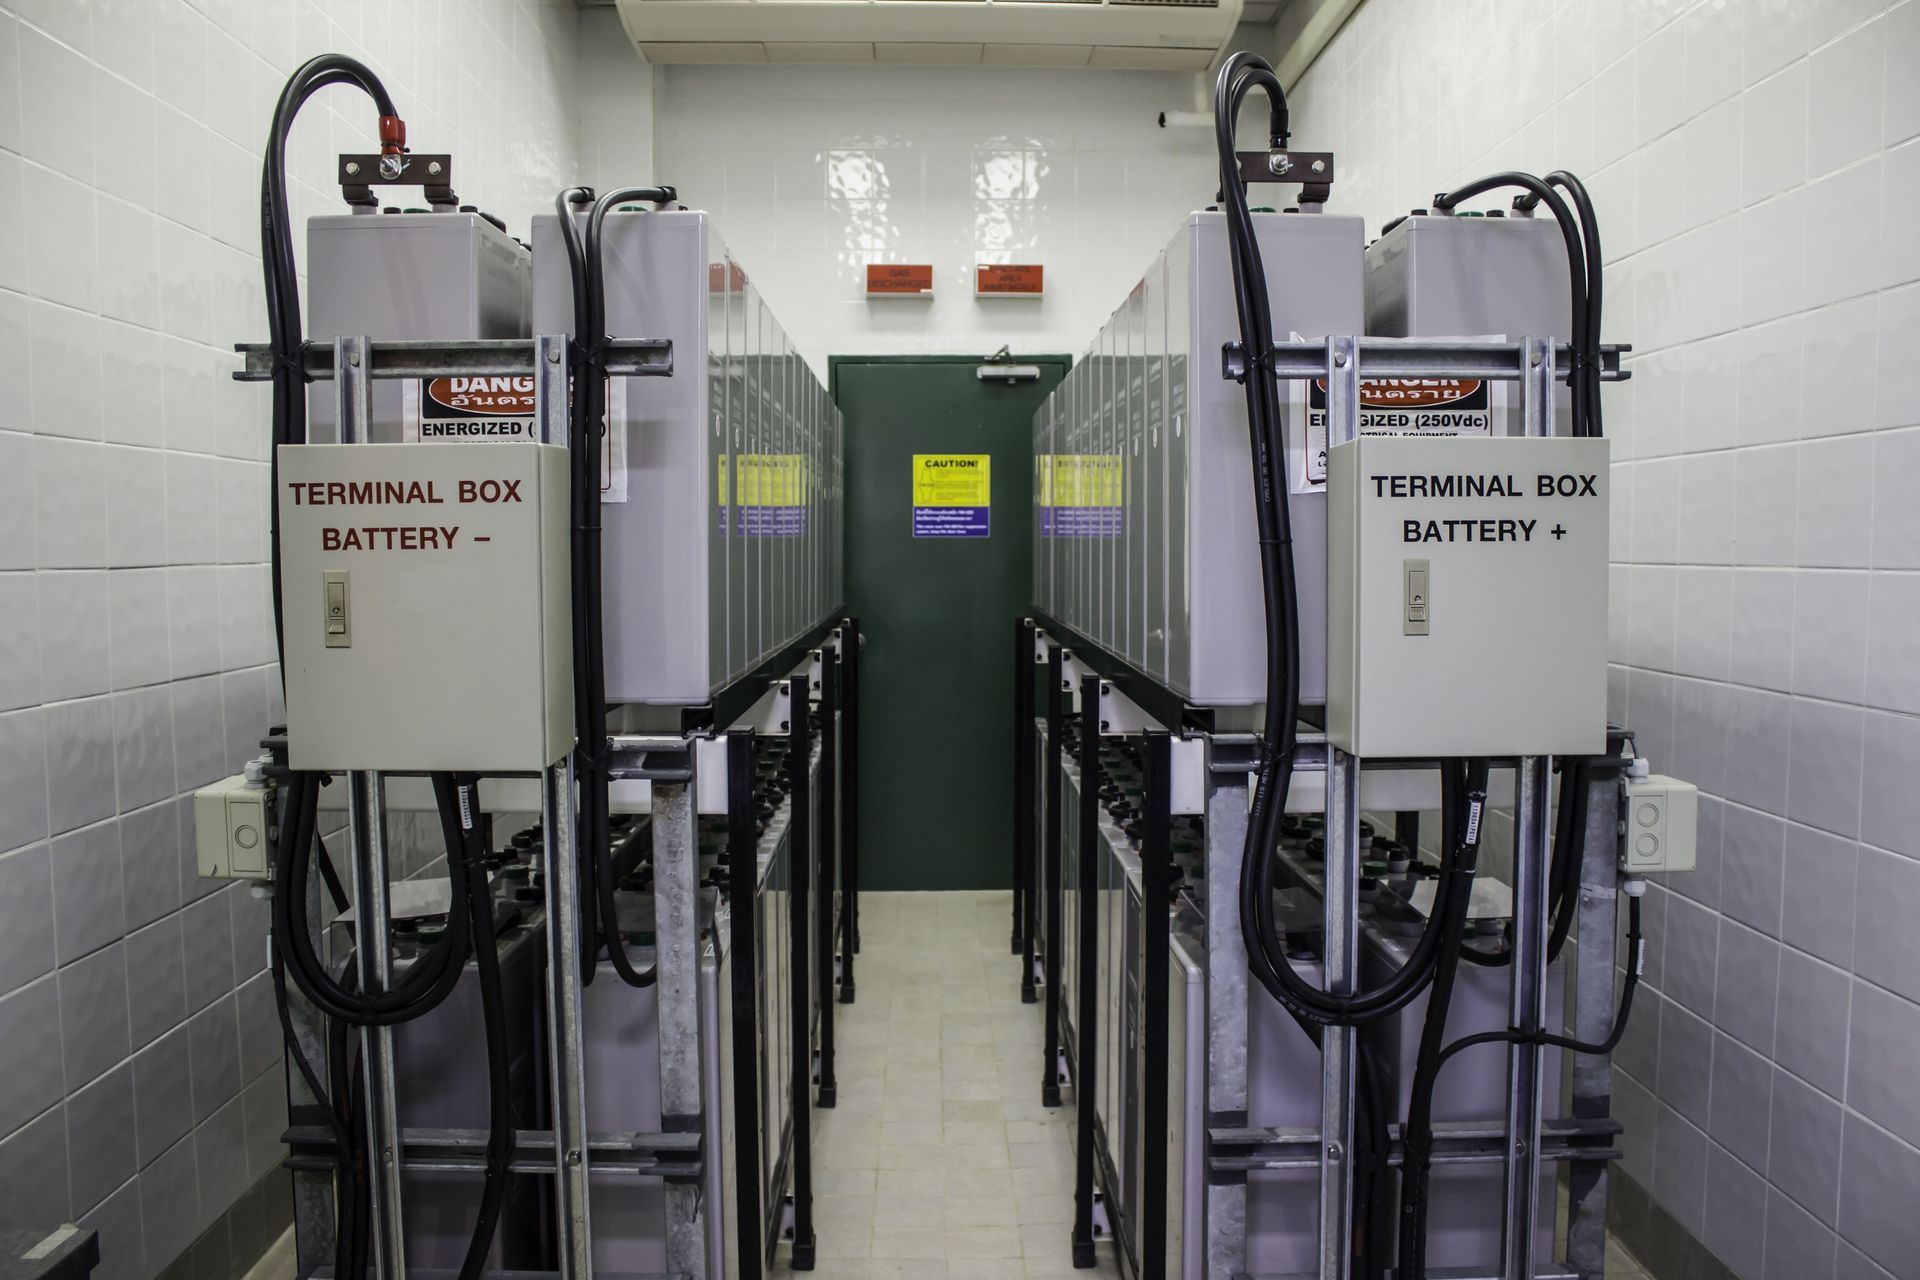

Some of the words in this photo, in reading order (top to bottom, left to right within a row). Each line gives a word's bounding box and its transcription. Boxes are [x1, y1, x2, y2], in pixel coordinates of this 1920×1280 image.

[422, 422, 522, 436] ENERGIZED
[1415, 414, 1489, 430] (250Vdc)
[925, 459, 978, 468] CAUTION!
[289, 481, 444, 506] TERMINAL
[458, 479, 523, 503] BOX
[1371, 474, 1523, 498] TERMINAL
[1537, 474, 1598, 497] BOX
[322, 526, 460, 551] BATTERY
[1403, 519, 1537, 543] BATTERY
